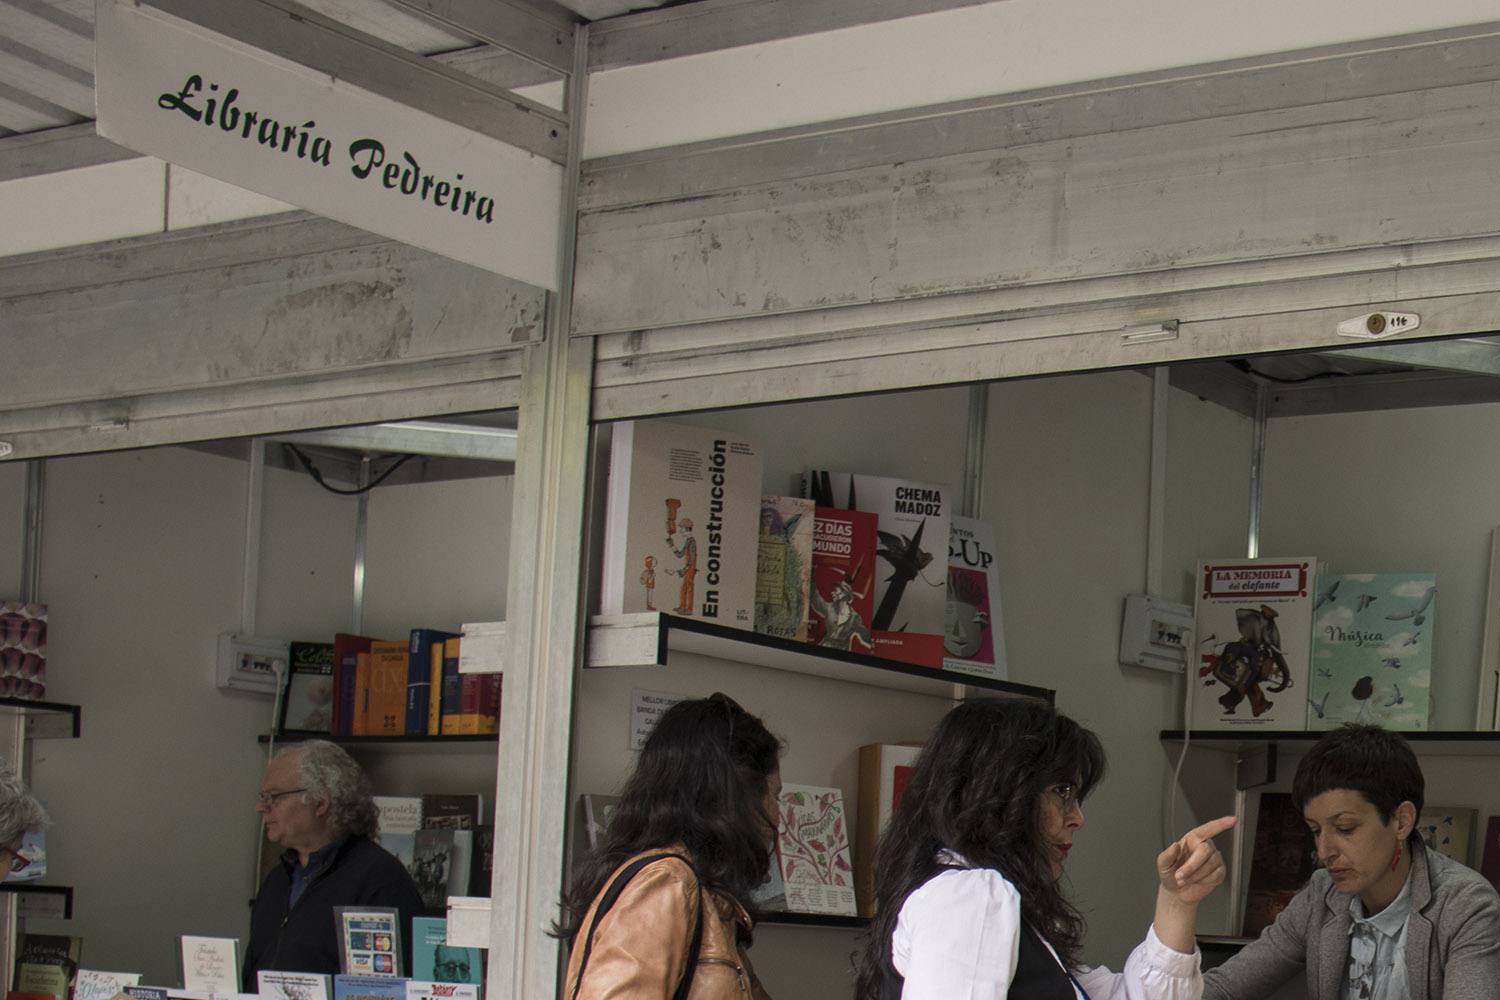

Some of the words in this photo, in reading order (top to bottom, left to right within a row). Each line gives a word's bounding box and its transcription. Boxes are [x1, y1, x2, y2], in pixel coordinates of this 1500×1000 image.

[158, 74, 332, 166] Libraría
[349, 138, 495, 224] Pedreira
[895, 486, 942, 503] CHEMA
[706, 439, 727, 586] construcción
[894, 500, 941, 517] MADOZ
[825, 520, 853, 536] DÍAS
[950, 527, 974, 538] NTOS
[813, 542, 851, 554] MUNDO
[1215, 571, 1232, 581] LA
[1234, 570, 1292, 580] MEMORIA
[1228, 581, 1241, 590] del
[1242, 580, 1280, 591] elefante
[702, 590, 719, 618] En
